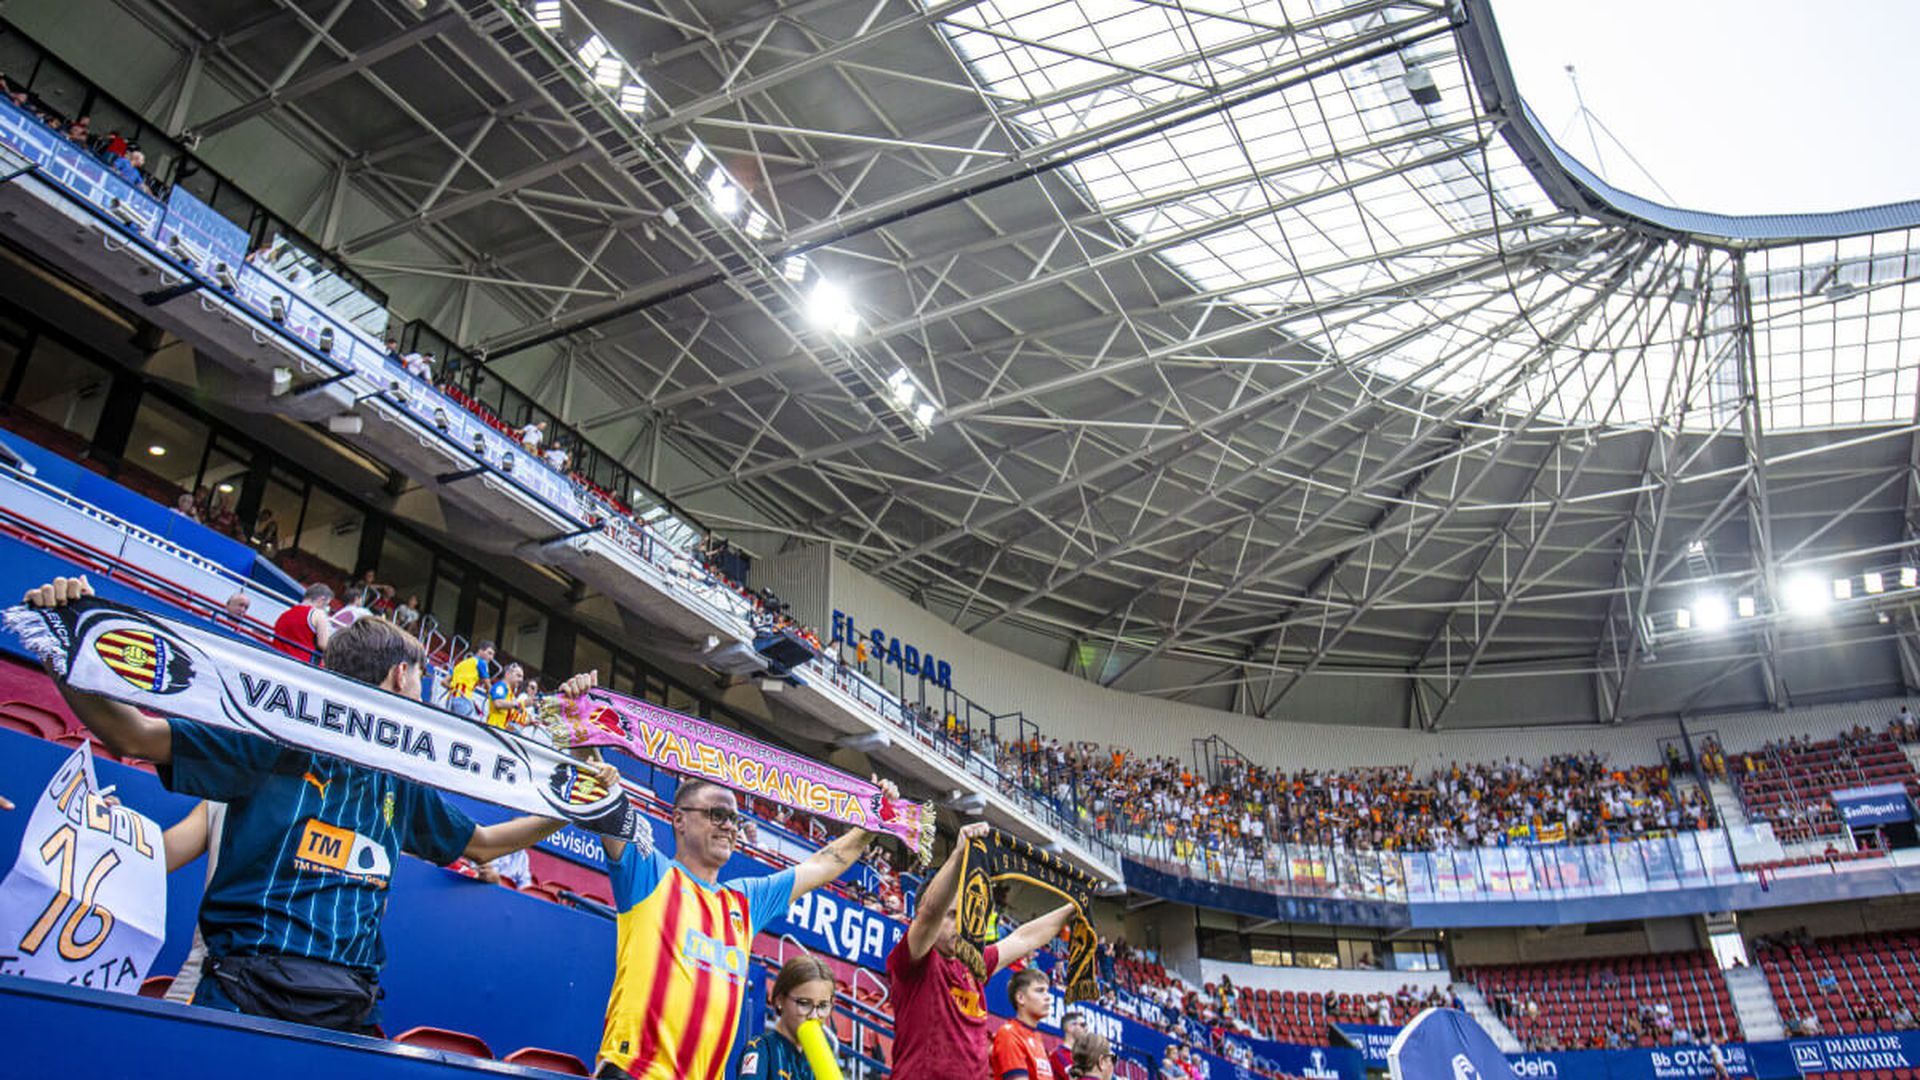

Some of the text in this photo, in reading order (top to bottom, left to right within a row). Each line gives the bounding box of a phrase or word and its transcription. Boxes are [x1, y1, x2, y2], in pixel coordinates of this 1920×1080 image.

[832, 608, 952, 691] EL SADAR
[239, 672, 517, 784] VALENCIA C. F.
[714, 731, 735, 746] POR
[639, 721, 867, 827] VALENCIANISTA
[308, 831, 343, 858] TM
[546, 830, 605, 863] evisión
[19, 823, 121, 962] 16
[1795, 1046, 1820, 1060] DN
[1824, 1036, 1902, 1054] DIARIO DE
[1829, 1052, 1910, 1070] NAVARRA
